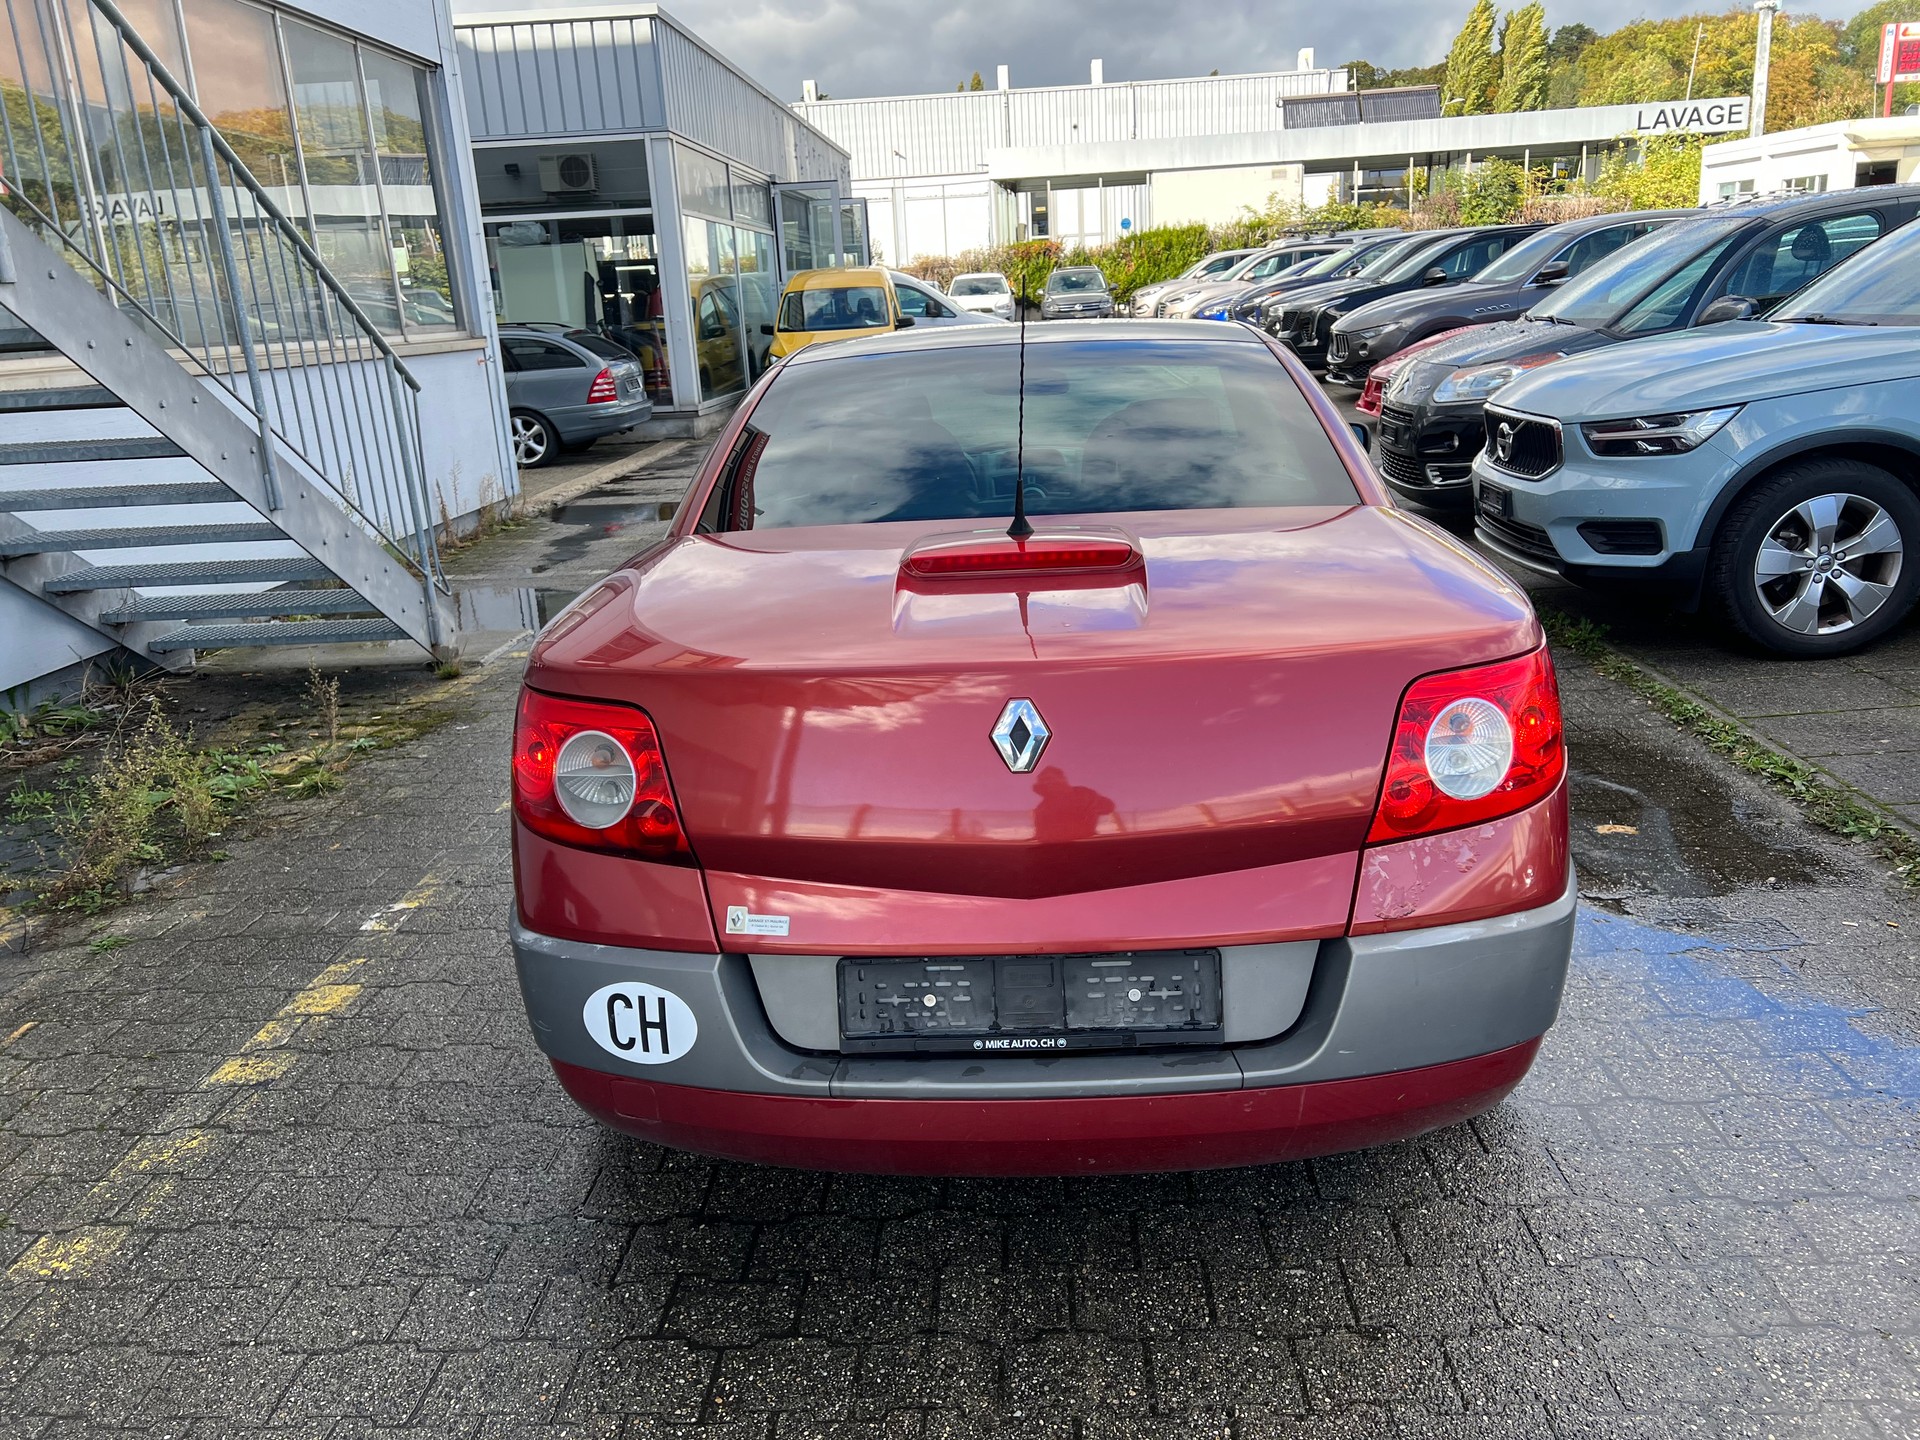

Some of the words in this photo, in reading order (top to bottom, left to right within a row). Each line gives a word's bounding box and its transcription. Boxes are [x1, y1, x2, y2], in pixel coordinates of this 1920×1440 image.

[1637, 103, 1743, 131] LAVAGE
[606, 992, 670, 1055] CH
[985, 1039, 1010, 1049] MIKE
[1010, 1038, 1055, 1048] AUTO.CH
